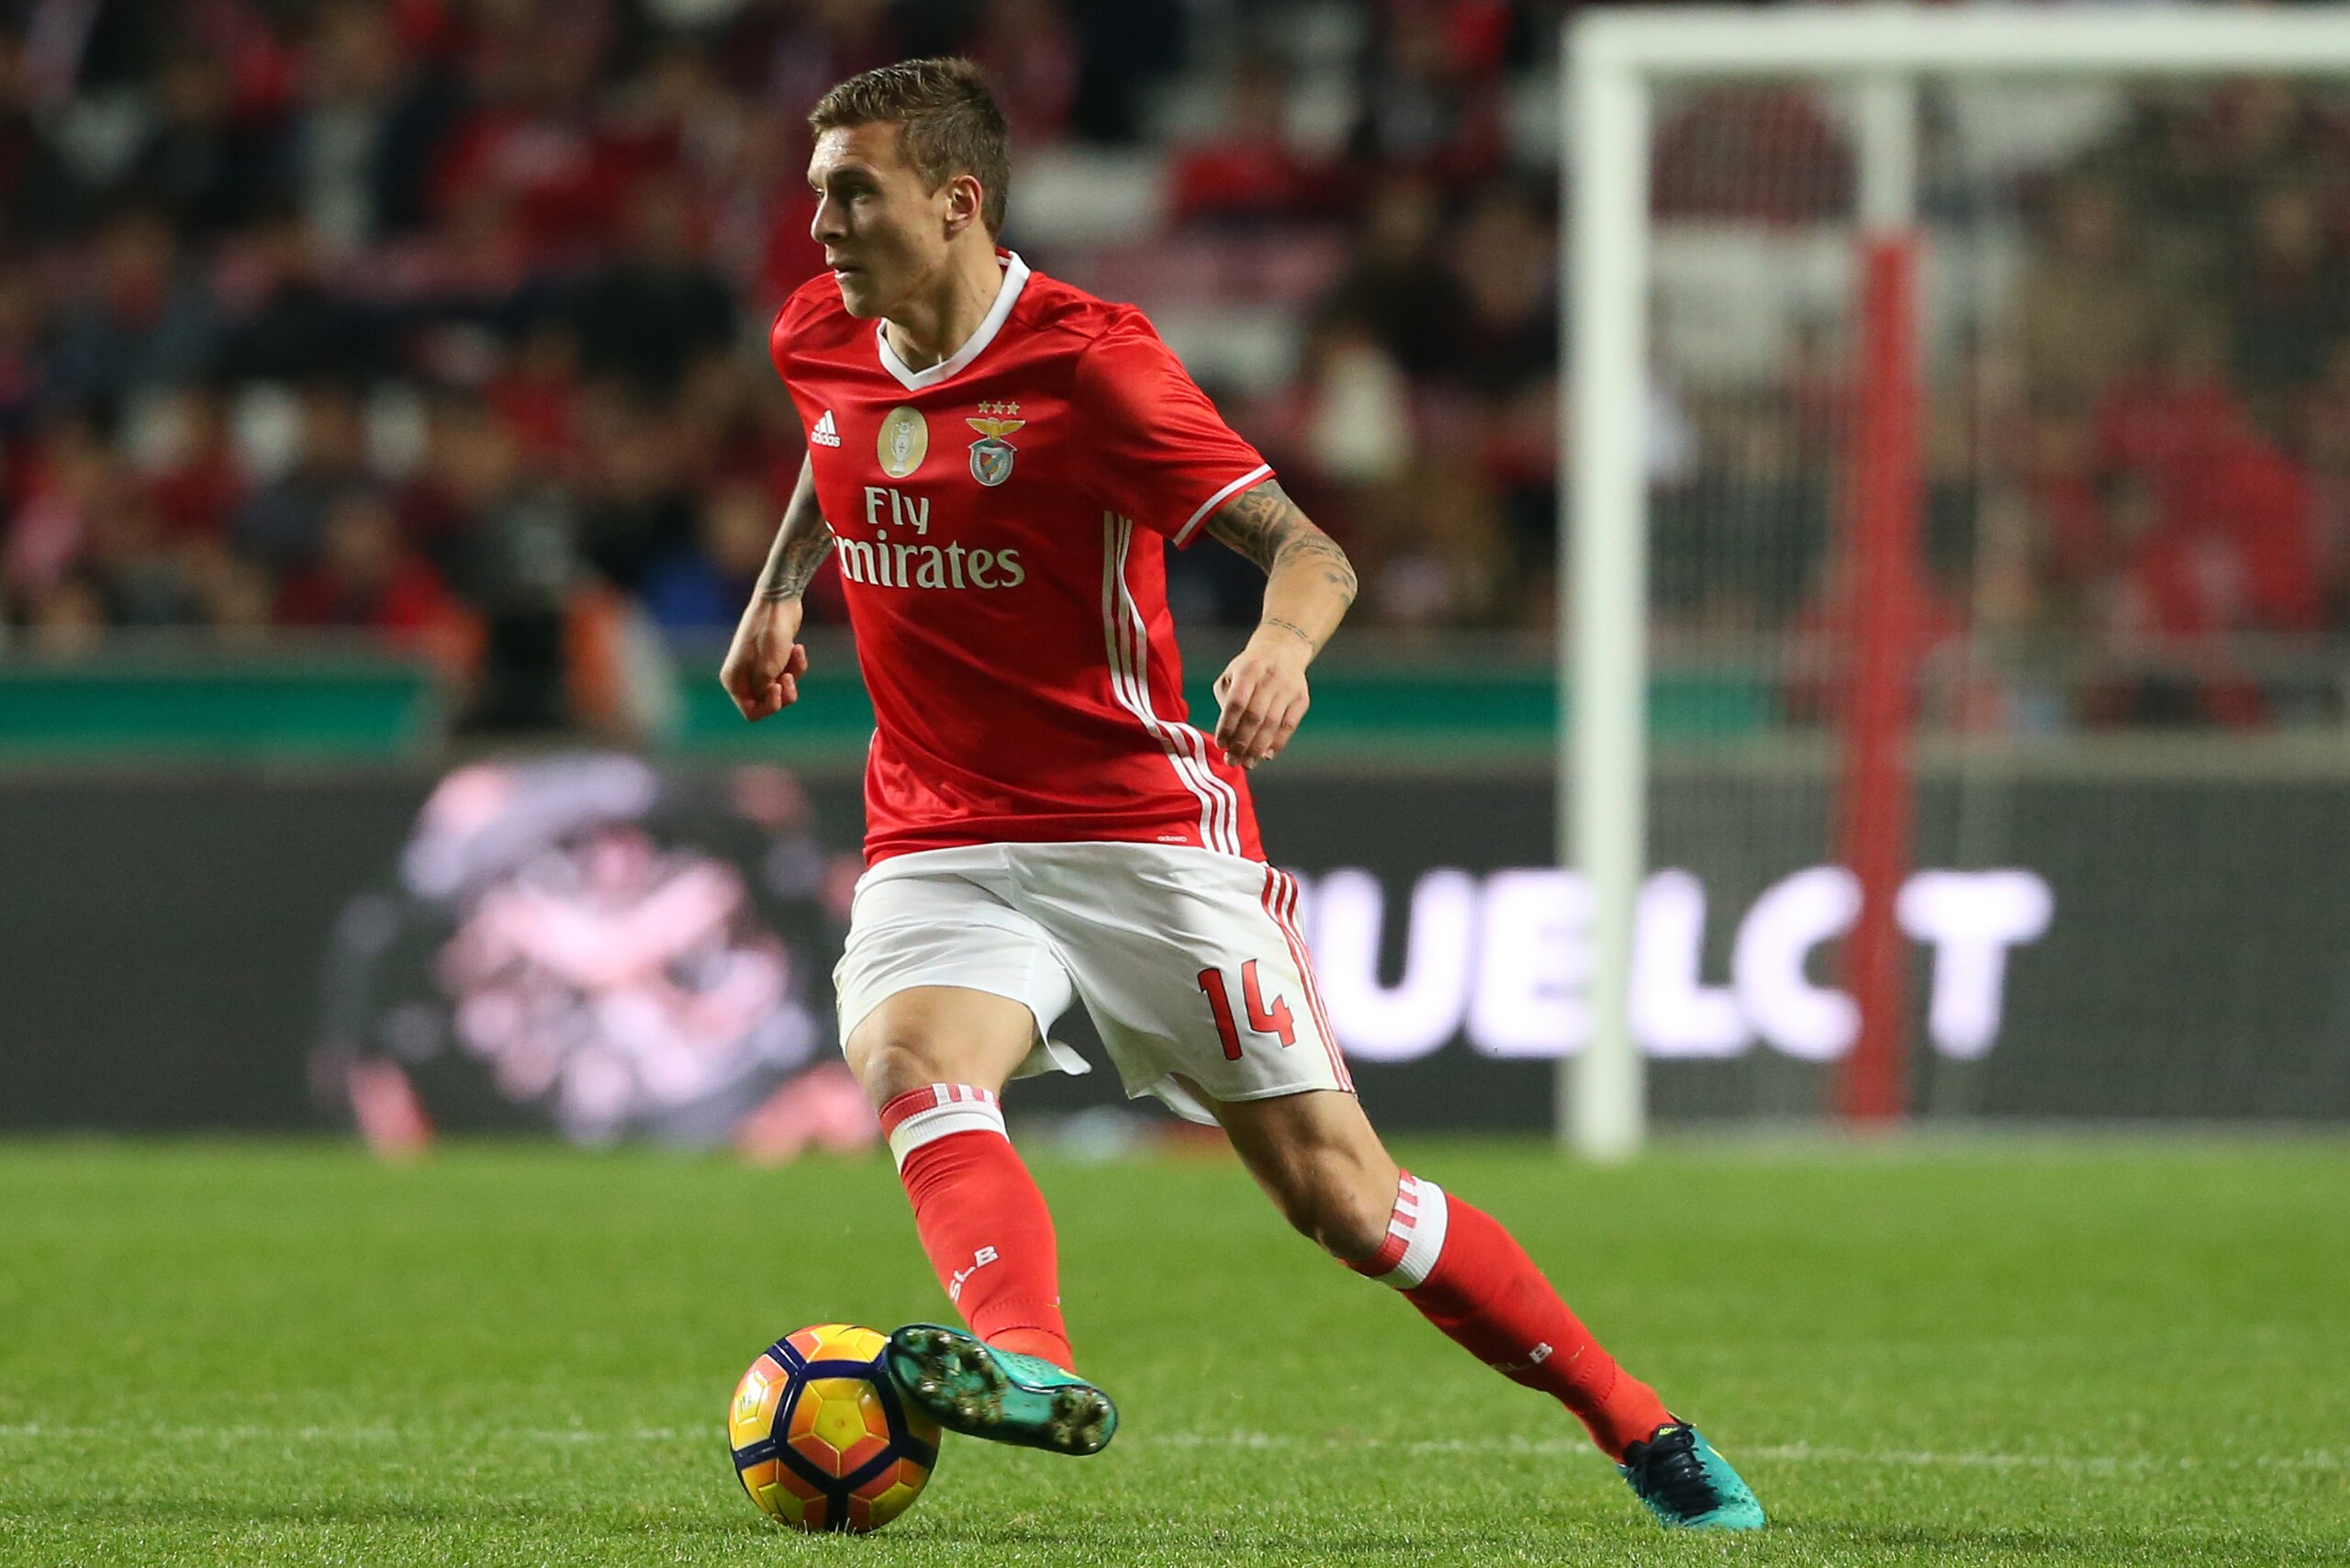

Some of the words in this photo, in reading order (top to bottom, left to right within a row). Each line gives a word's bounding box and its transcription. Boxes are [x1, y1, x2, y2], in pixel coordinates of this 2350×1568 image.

[811, 431, 841, 448] adidas
[864, 487, 929, 534] Fly
[1197, 958, 1296, 1061] 14
[949, 1245, 1000, 1303] SLB
